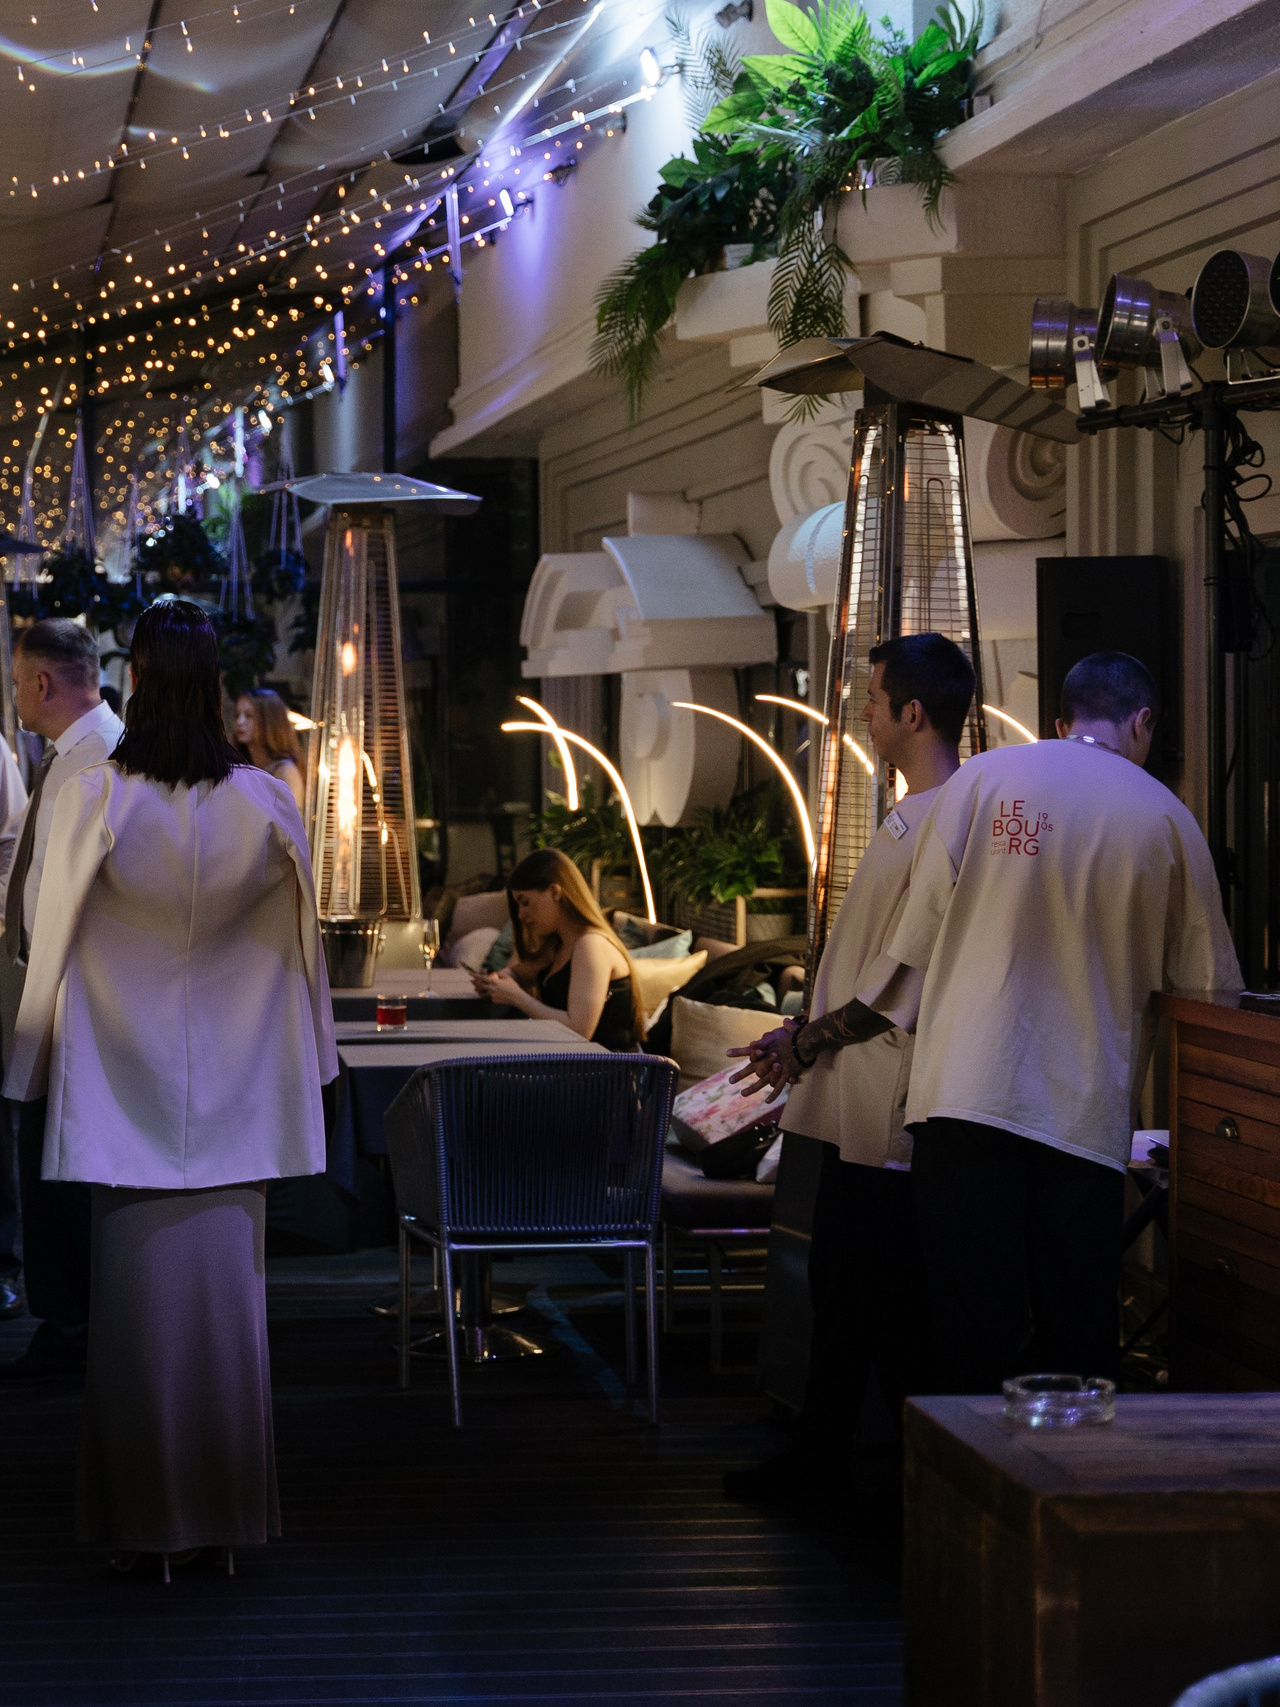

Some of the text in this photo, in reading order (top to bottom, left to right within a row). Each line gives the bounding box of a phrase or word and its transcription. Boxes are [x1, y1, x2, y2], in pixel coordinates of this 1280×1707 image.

[1000, 800, 1025, 817] LE
[1038, 812, 1048, 821] 19
[993, 818, 1040, 837] BOU
[1041, 822, 1054, 832] 05
[1008, 837, 1040, 856] RG
